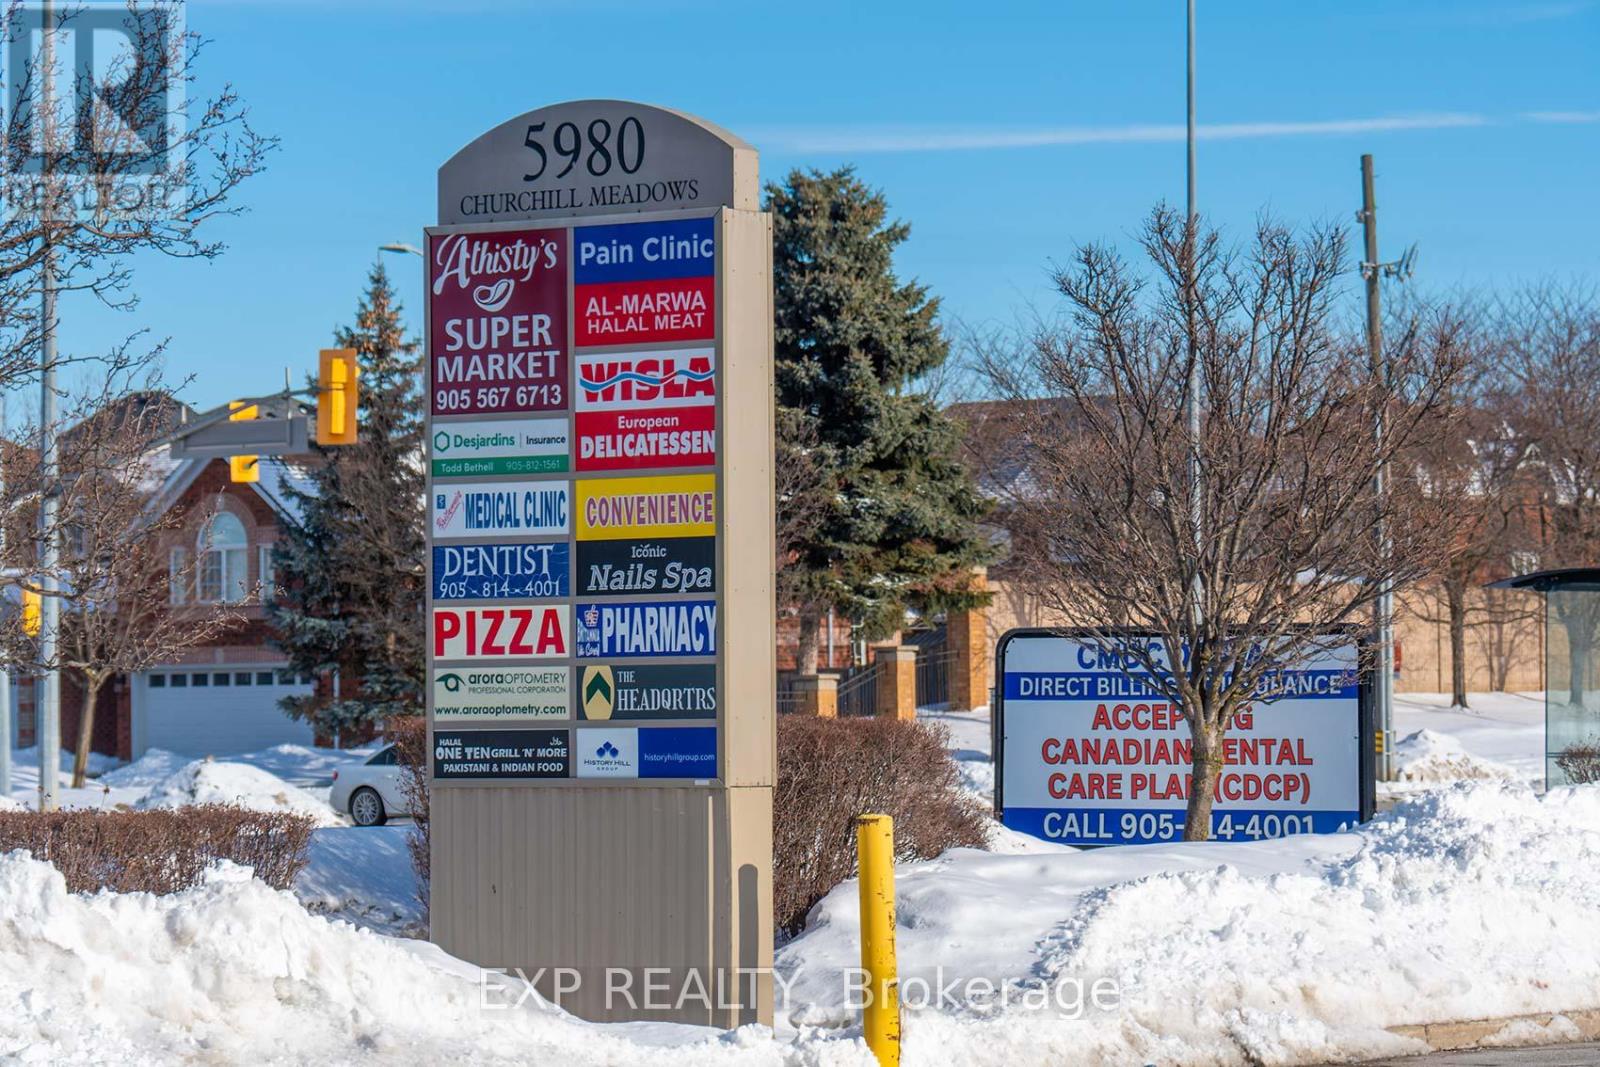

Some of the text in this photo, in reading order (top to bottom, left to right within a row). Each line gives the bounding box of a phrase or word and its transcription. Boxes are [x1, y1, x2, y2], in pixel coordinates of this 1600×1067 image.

[523, 117, 645, 182] 5980
[461, 179, 699, 216] CHURCHILL MEADOWS
[580, 234, 714, 266] Pain Clinic
[432, 234, 558, 296] Athisty's
[586, 290, 707, 317] AL-MARWA
[445, 314, 552, 351] SUPER
[588, 312, 704, 334] HALAL MEAT
[437, 350, 560, 383] MARKET
[580, 356, 715, 403] WISLA
[437, 384, 562, 410] 905 567 6713
[618, 415, 679, 430] European
[454, 432, 566, 450] Desjardins Insurance
[580, 430, 715, 460] DELICATESSEN
[441, 462, 462, 473] Todd
[464, 461, 494, 472] Bethell
[465, 491, 520, 529] MEDICAL
[524, 490, 566, 528] CLINIC
[586, 492, 713, 529] CONVENIENCE
[445, 544, 554, 577] DENTIST
[588, 562, 712, 593] Nails Spa
[434, 609, 566, 656] PIZZA
[602, 605, 716, 653] PHARMACY
[468, 685, 566, 695] PROFESSIONAL CORPORATION
[617, 671, 635, 683] THE
[1020, 677, 1091, 697] DIRECT
[435, 704, 566, 717] www.aroraoptometry.com
[617, 687, 716, 712] HEADQRTRS
[435, 747, 462, 760] ONE
[491, 748, 520, 758] GRILL
[537, 747, 567, 758] MORE
[439, 738, 462, 747] HALAL
[1041, 738, 1313, 766] CANADIAN ENTAL
[443, 762, 563, 773] PAKISTANI & INDIAN FOOD
[644, 752, 715, 763] historyhillgroup.com
[1048, 772, 1122, 800] CARE
[1214, 772, 1311, 804] (CDCP)
[1043, 812, 1314, 840] CALL 905-14-4001
